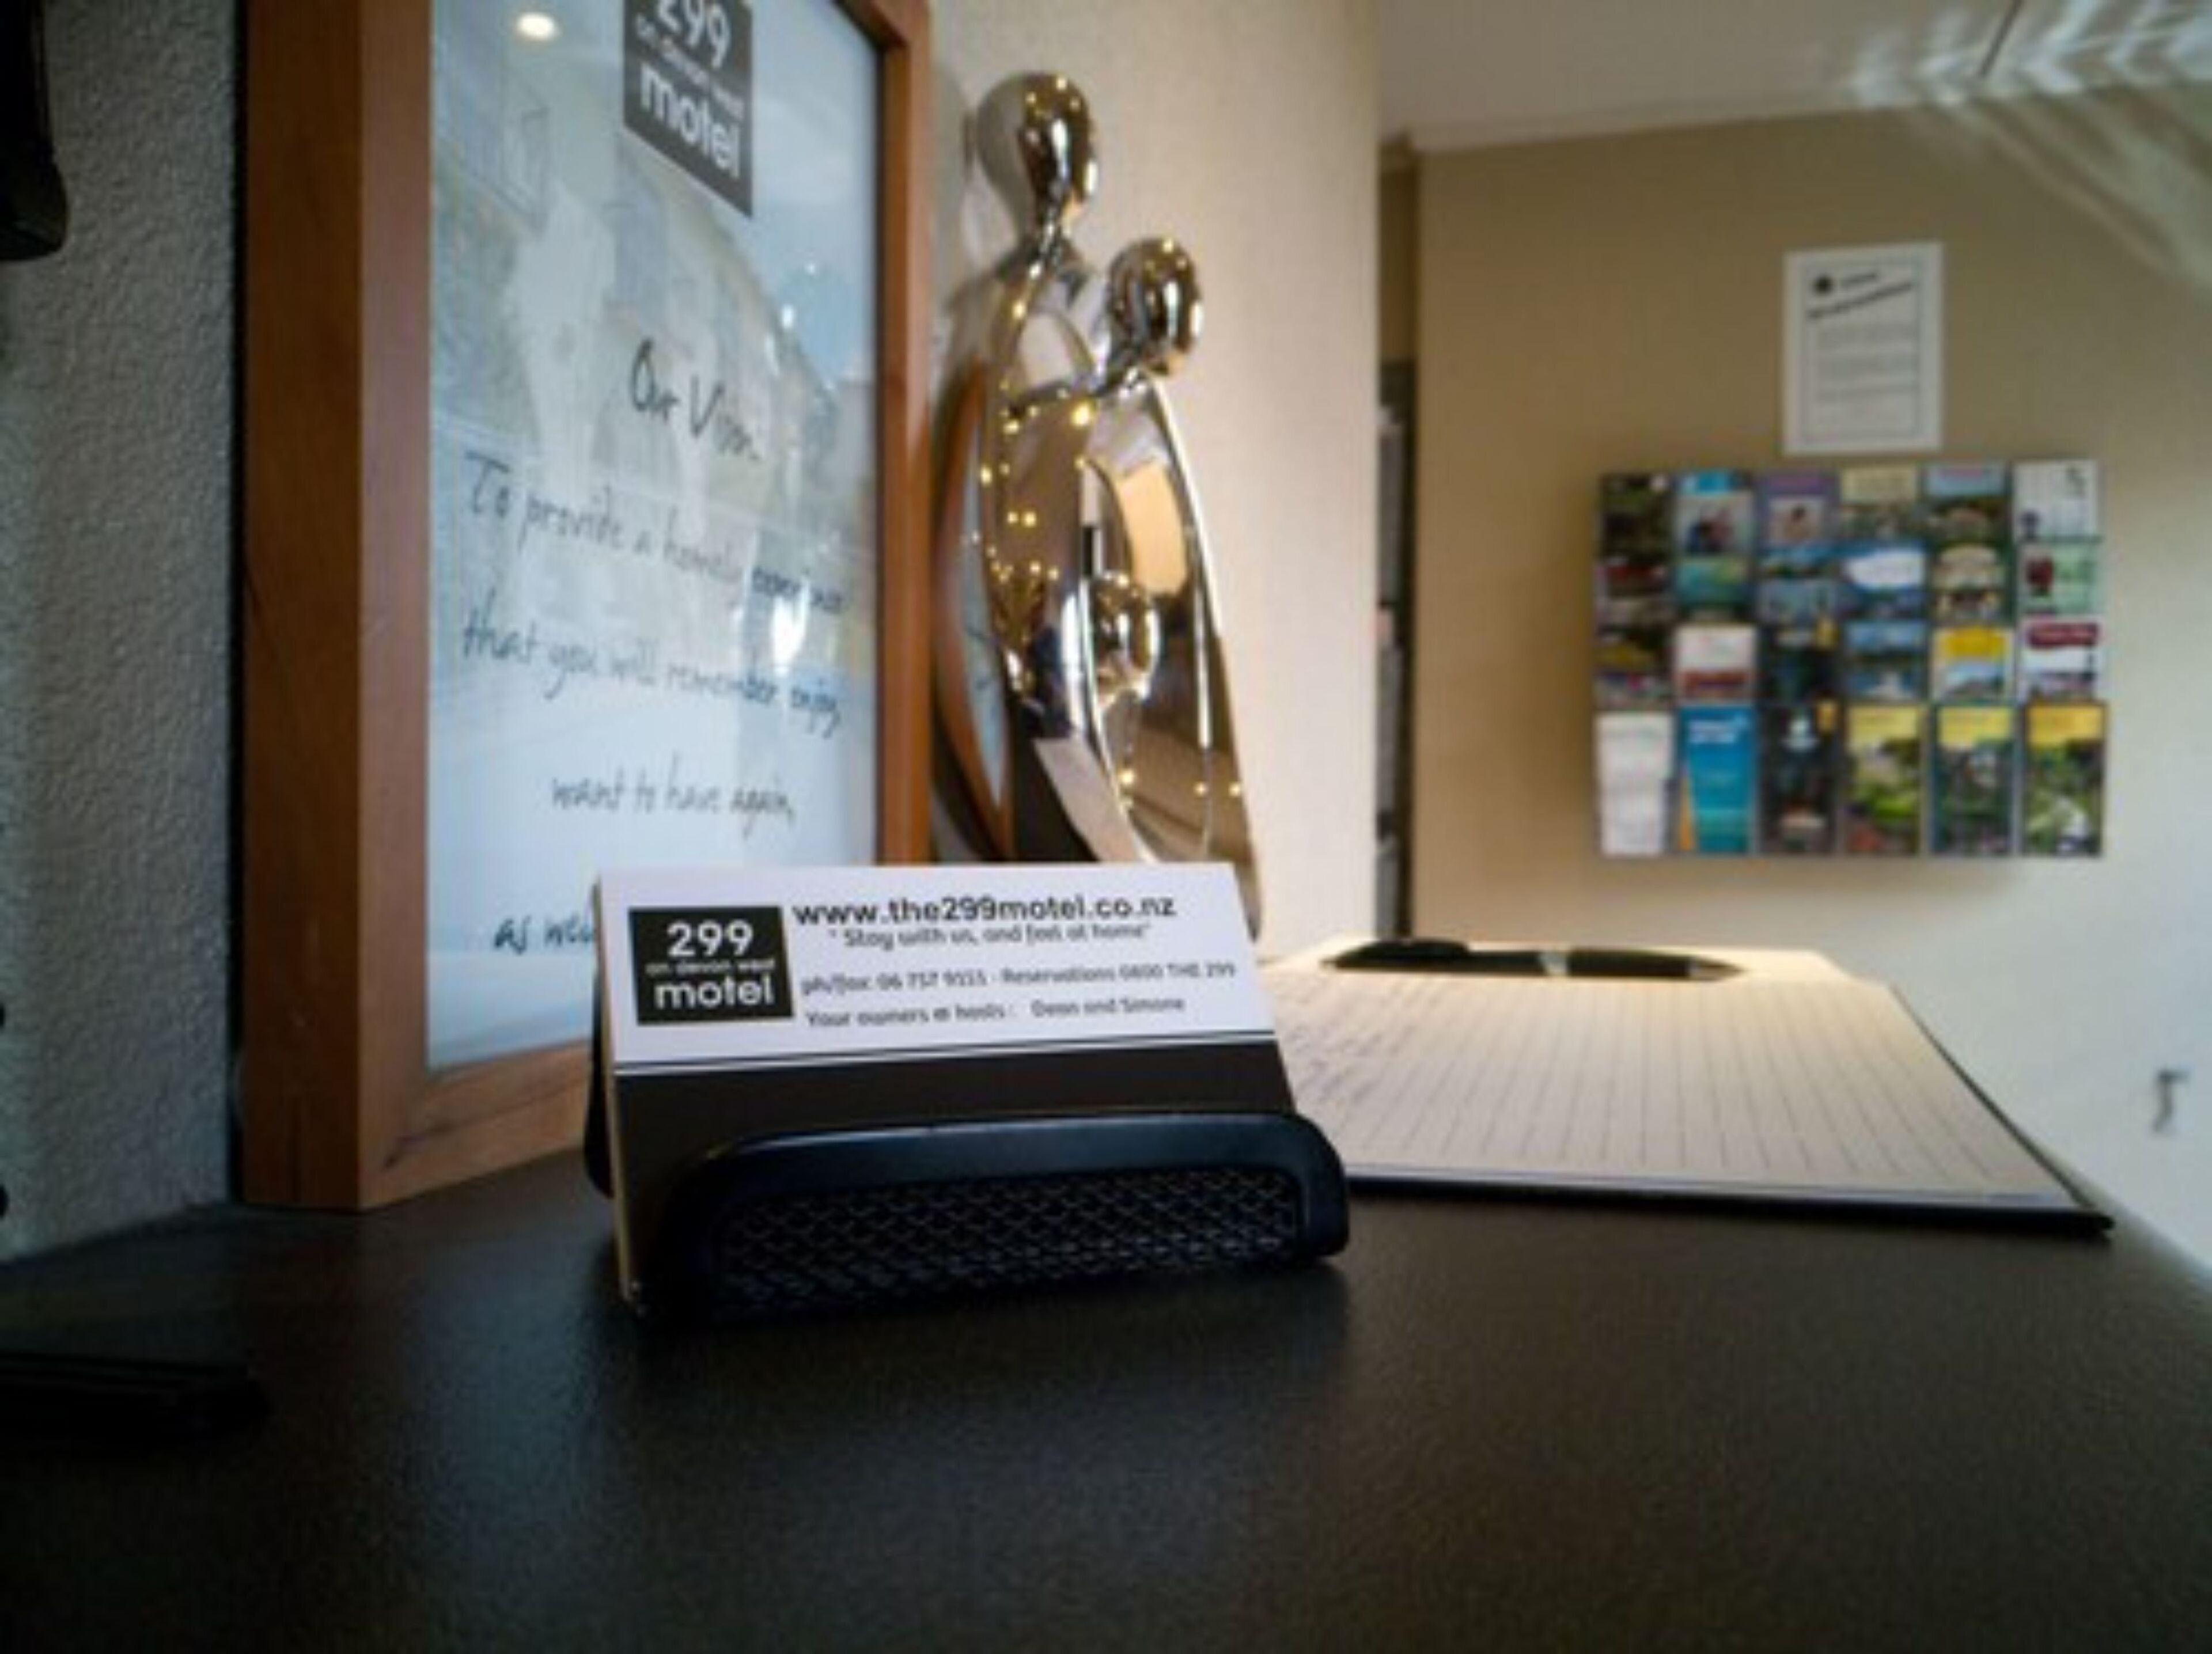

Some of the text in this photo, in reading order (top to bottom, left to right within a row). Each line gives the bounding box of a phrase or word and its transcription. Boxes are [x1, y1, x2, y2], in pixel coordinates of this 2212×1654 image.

[641, 62, 740, 179] motel
[463, 449, 511, 517] To
[464, 587, 537, 665] that
[543, 644, 598, 700] you
[551, 765, 624, 812] want
[632, 768, 657, 813] to
[666, 750, 722, 813] have
[791, 893, 1177, 925] www.the299motel.co.nz
[666, 920, 754, 957] 299
[843, 928, 894, 951] Stay
[897, 927, 946, 947] with
[982, 924, 1021, 943] and
[654, 972, 774, 1010] motel
